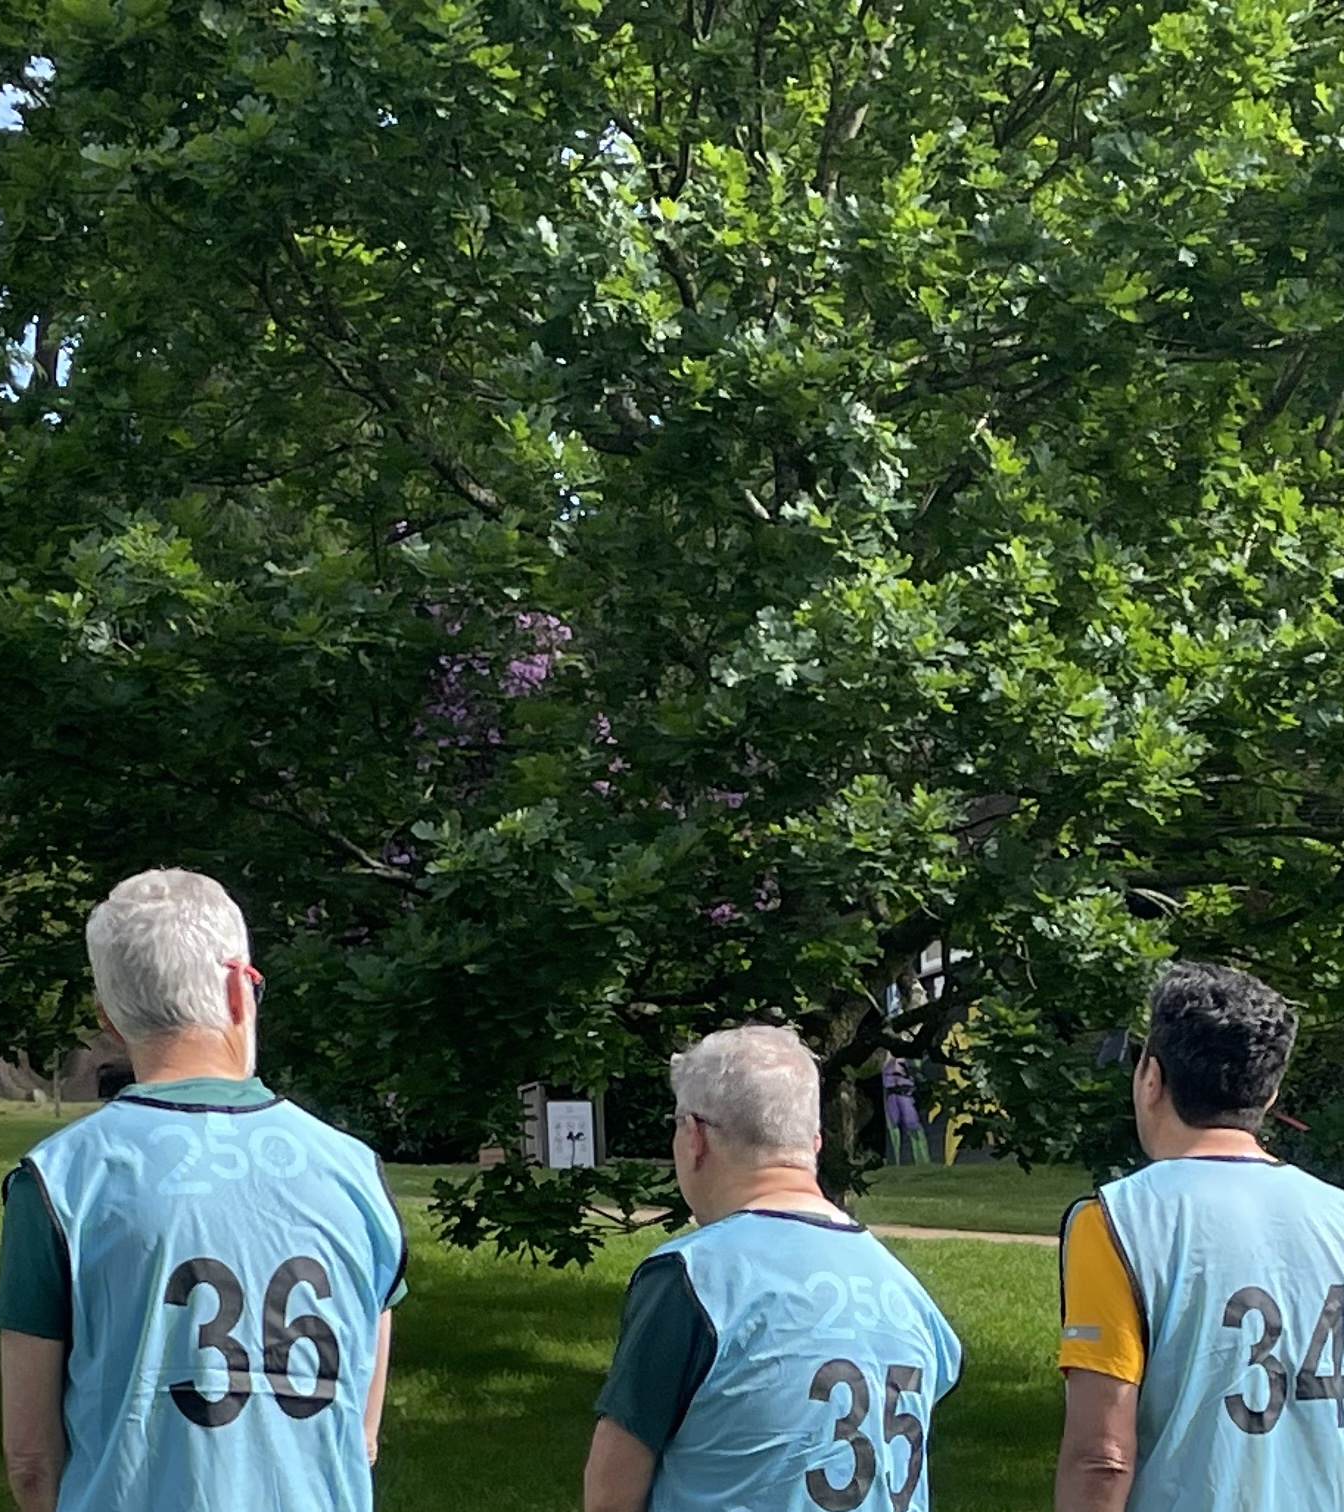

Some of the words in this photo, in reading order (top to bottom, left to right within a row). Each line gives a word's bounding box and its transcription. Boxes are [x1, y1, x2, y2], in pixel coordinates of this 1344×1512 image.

[152, 1124, 307, 1194] 250
[805, 1271, 912, 1339] 250
[164, 1256, 340, 1428] 36
